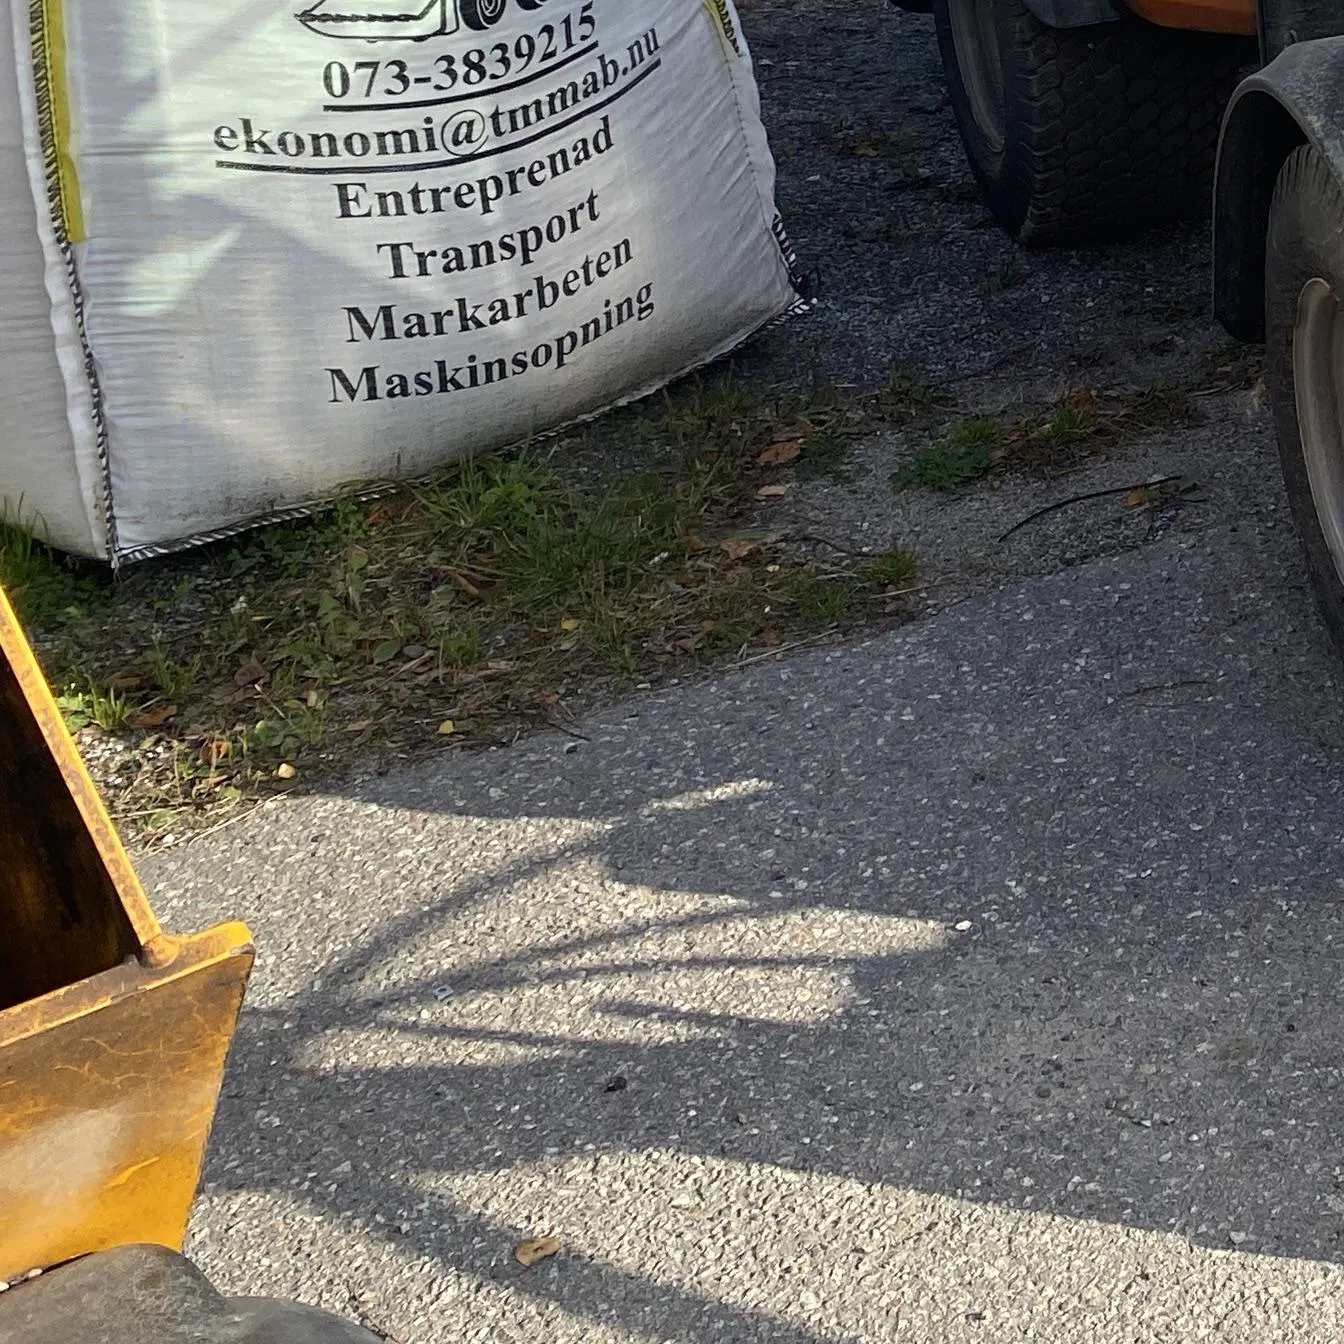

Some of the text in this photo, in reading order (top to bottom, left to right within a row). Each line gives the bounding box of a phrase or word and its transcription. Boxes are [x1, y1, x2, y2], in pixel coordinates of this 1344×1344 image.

[213, 26, 661, 158] ekonomi@tmmab.nu
[322, 0, 598, 99] 073-3839215
[334, 115, 615, 220] Entreprenad
[376, 188, 601, 280] Transport
[341, 237, 634, 343] Markarbeten
[324, 282, 656, 404] Maskinsopning
